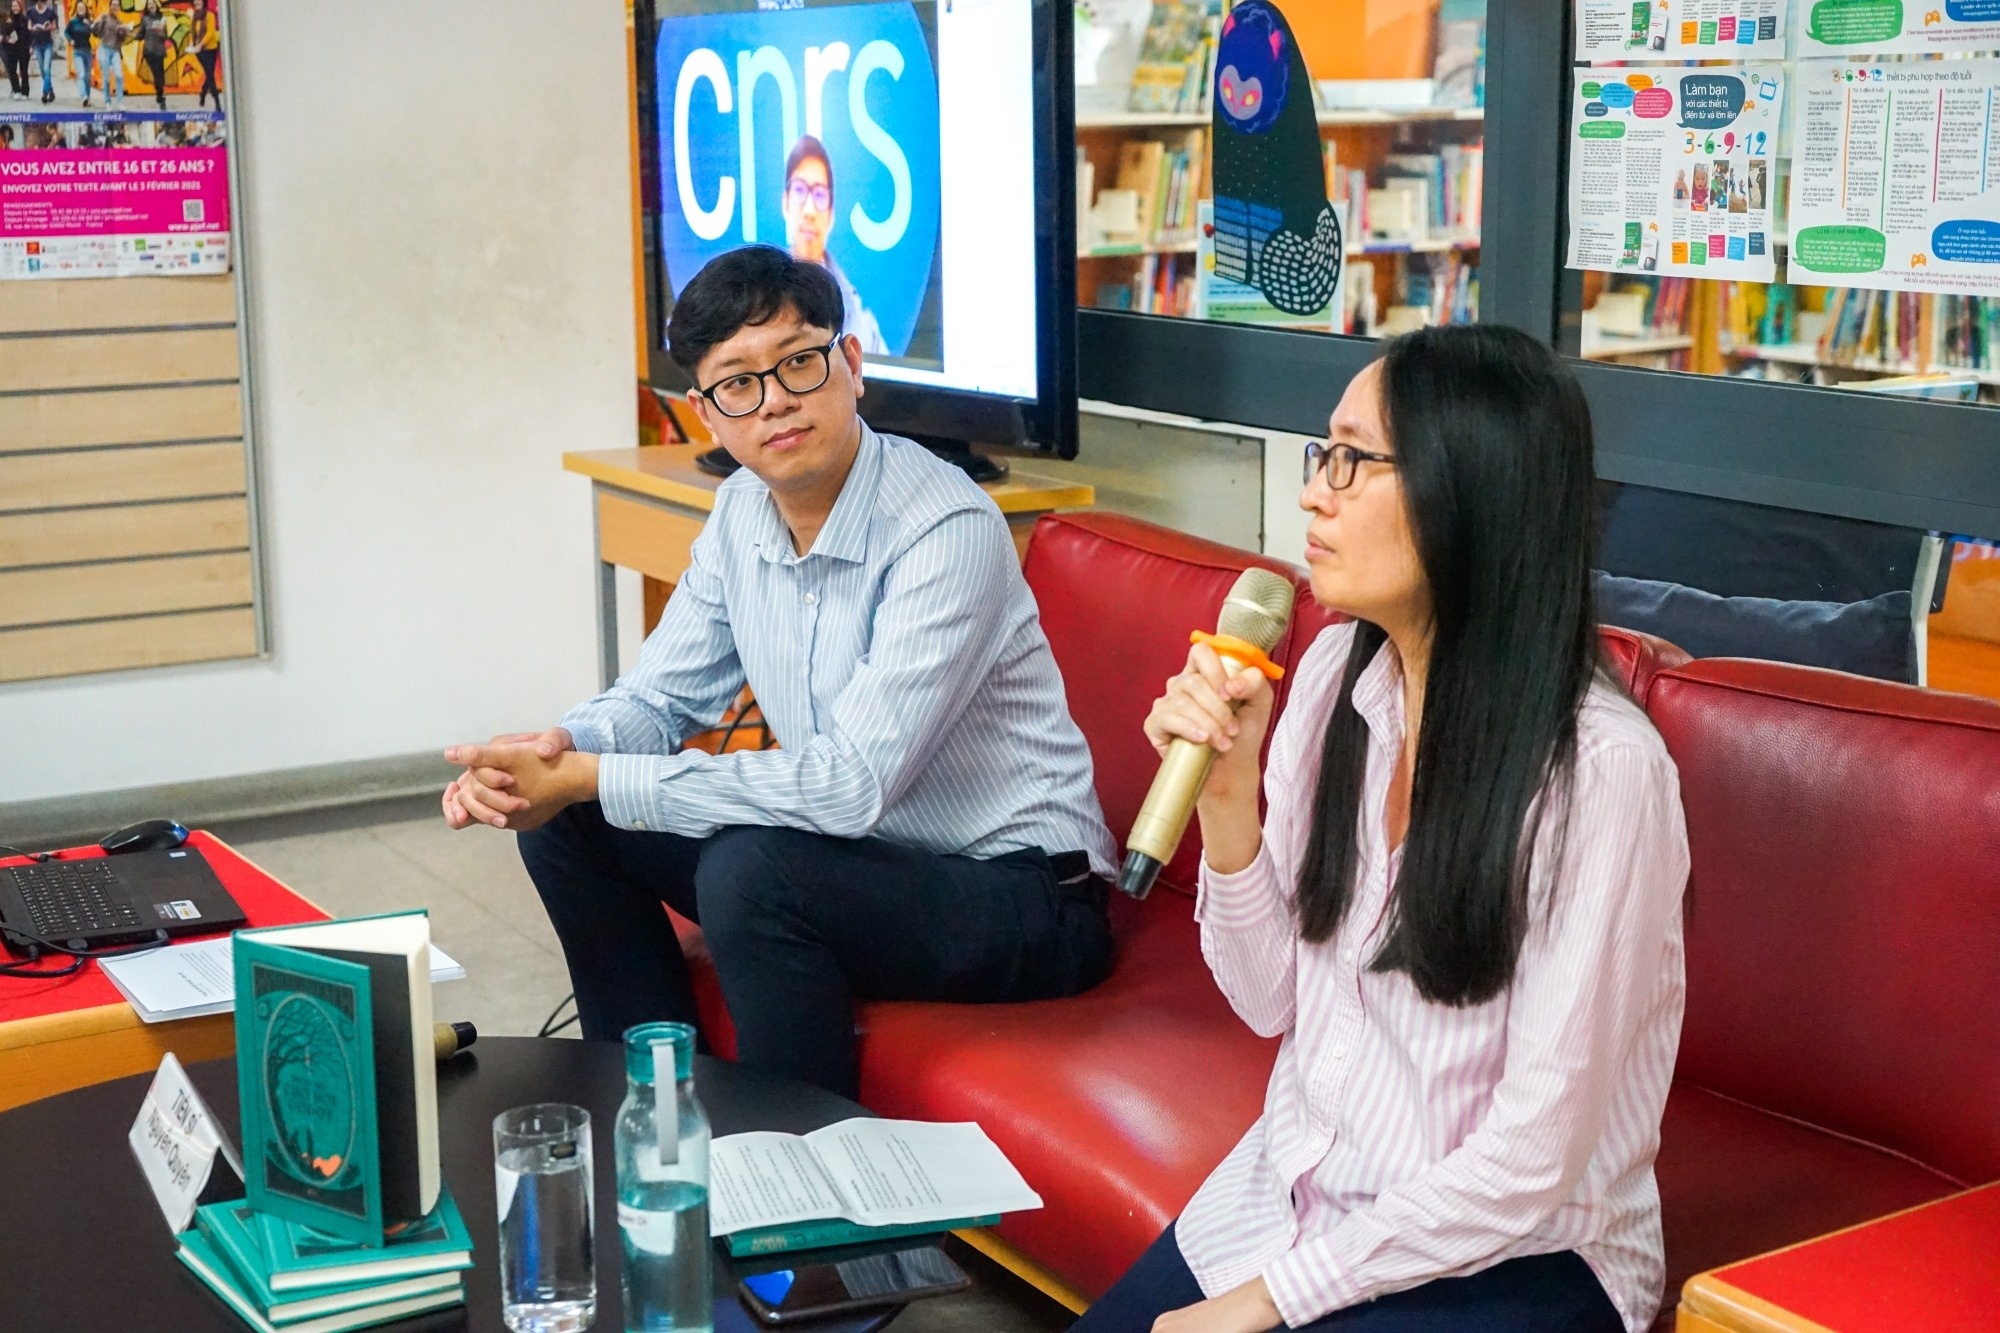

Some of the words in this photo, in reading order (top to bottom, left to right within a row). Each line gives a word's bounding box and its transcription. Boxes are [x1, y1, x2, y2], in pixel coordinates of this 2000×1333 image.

[1686, 84, 1706, 95] Làm
[1710, 84, 1727, 98] bạn
[1709, 98, 1722, 107] thiết
[674, 39, 912, 252] cnrs
[0, 162, 40, 176] VOUS
[42, 162, 76, 175] AVEZ
[78, 161, 120, 175] ENTRE
[141, 160, 157, 174] ET
[160, 160, 176, 173] 26
[178, 160, 205, 173] ANS
[207, 159, 214, 173] ?
[2, 184, 42, 193] ENVOYEZ
[44, 183, 72, 192] VOTRE
[73, 183, 99, 192] TEXTE
[100, 182, 127, 191] AVANT
[128, 182, 138, 191] LE
[147, 181, 179, 190] FÉVRIER
